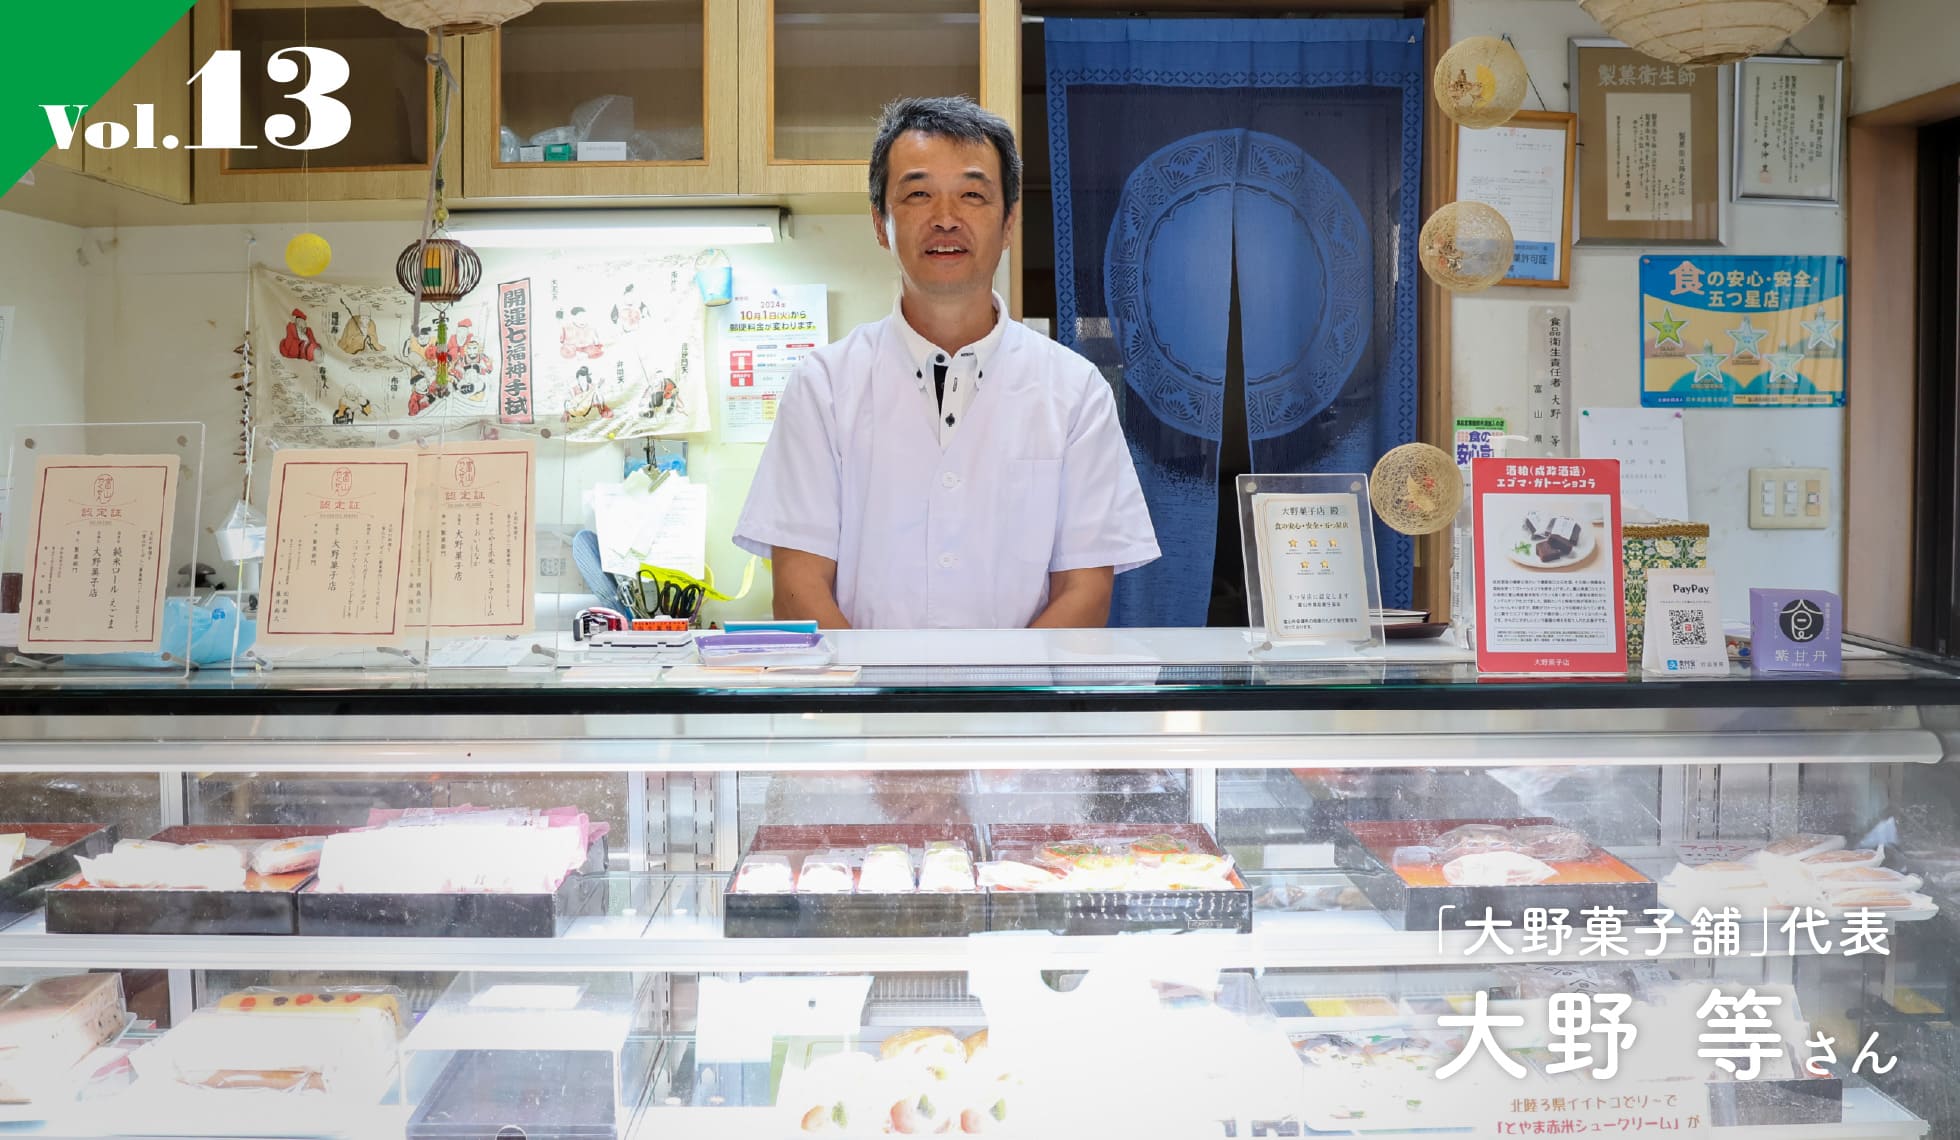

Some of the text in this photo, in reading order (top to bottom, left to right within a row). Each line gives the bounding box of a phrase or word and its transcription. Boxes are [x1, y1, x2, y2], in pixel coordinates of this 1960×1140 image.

[1598, 64, 1696, 87] 製菓衛生師
[1707, 290, 1780, 308] 五つ星店
[503, 287, 528, 416] 開運七福神手拭
[1549, 317, 1561, 388] 食品衛生責任者
[1496, 478, 1597, 489] エゴマ・ガトーショコラ
[81, 507, 122, 518] 認定証
[319, 500, 360, 510] 認定証
[1282, 505, 1325, 516] 大野菓子店
[453, 528, 465, 582] 大野菓子店
[88, 546, 102, 598] 大野菓子店
[328, 539, 342, 592] 大野菓子店
[1672, 583, 1710, 595] PayPay
